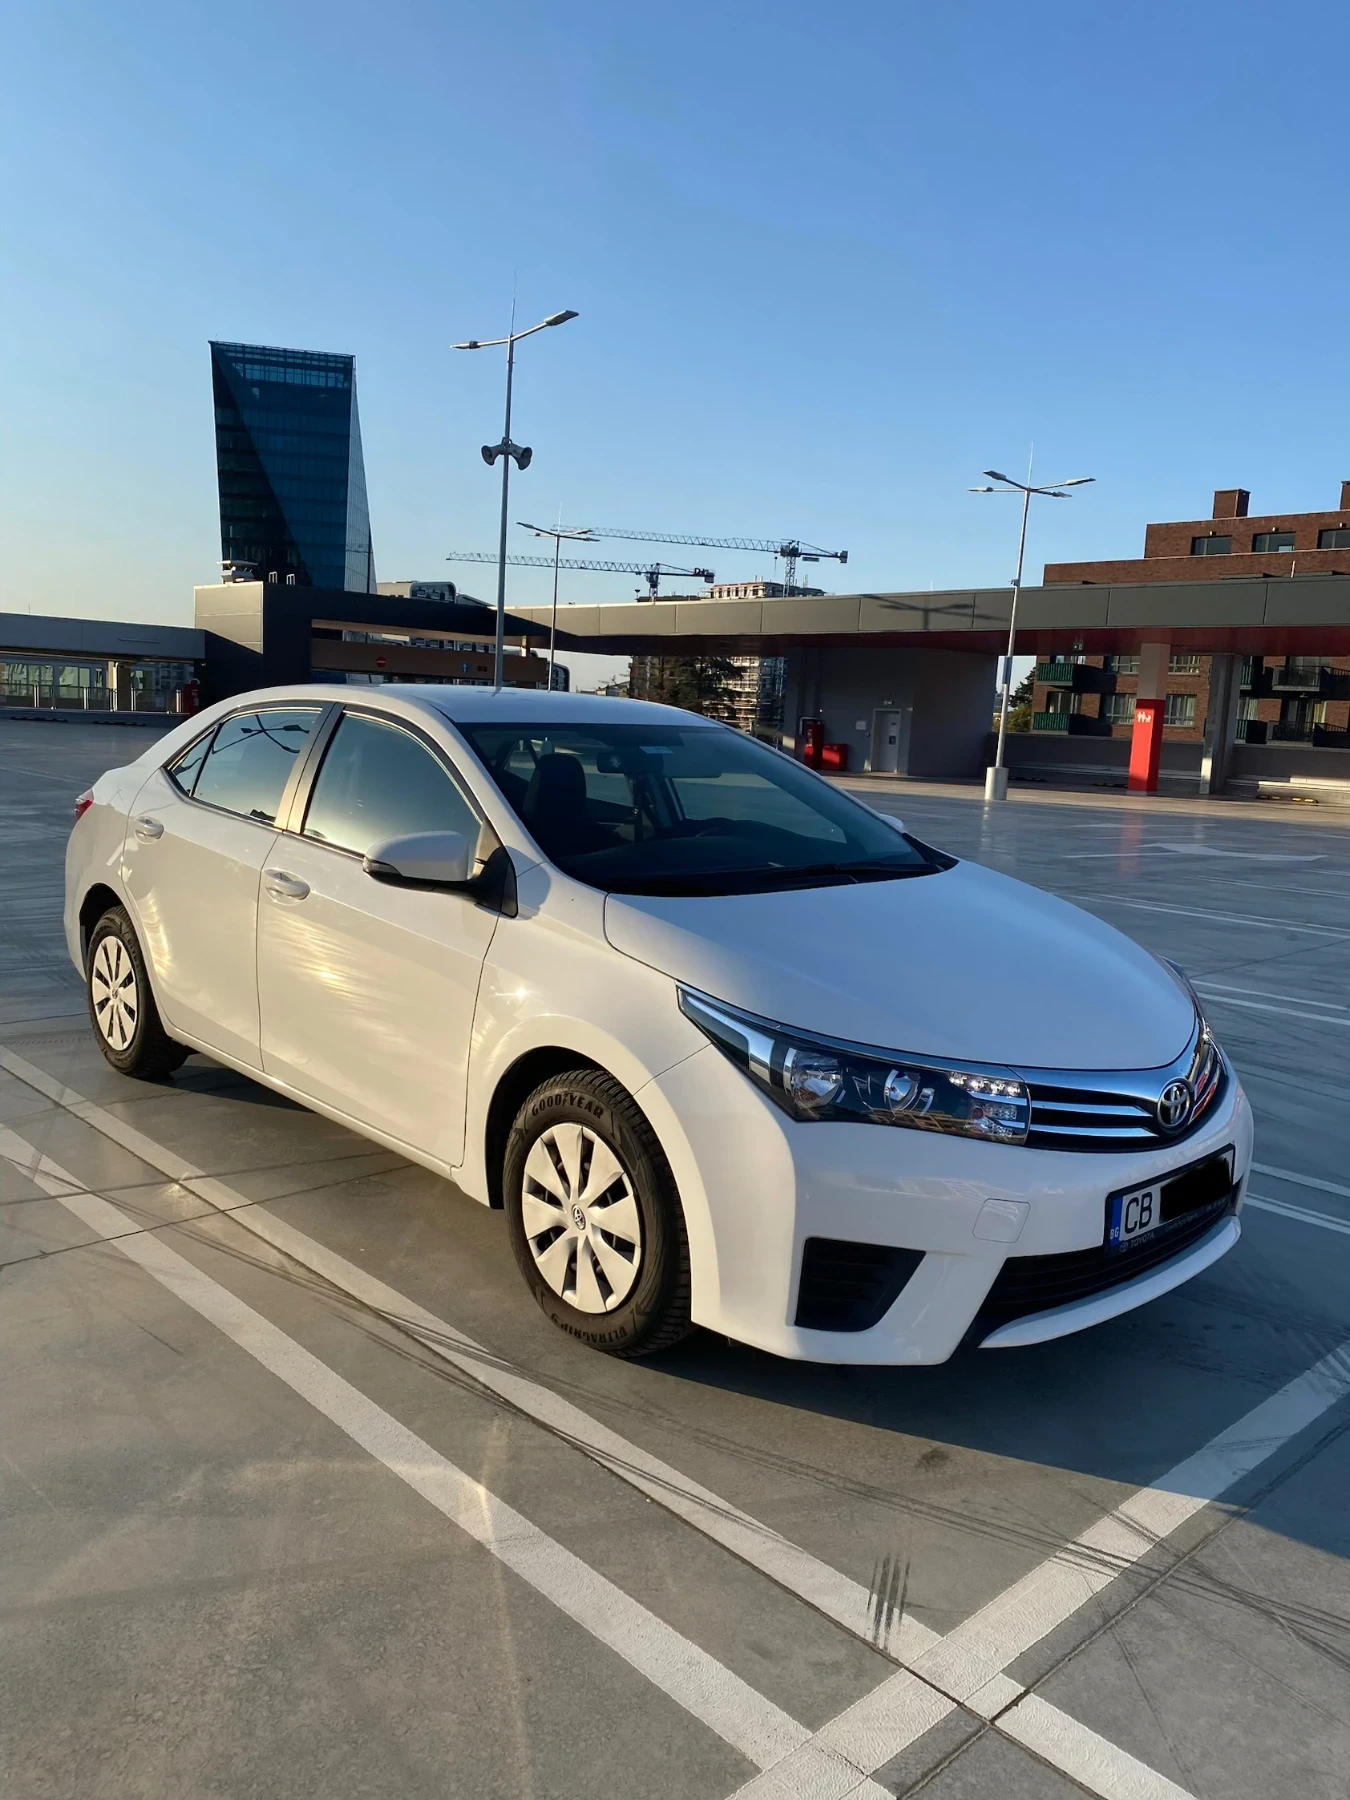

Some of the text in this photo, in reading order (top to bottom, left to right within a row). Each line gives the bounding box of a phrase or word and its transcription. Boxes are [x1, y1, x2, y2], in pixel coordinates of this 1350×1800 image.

[532, 1093, 604, 1119] GOODYEAR
[1124, 1191, 1153, 1234] CB
[1109, 1226, 1120, 1240] BG
[1130, 1231, 1155, 1248] TOYOTA
